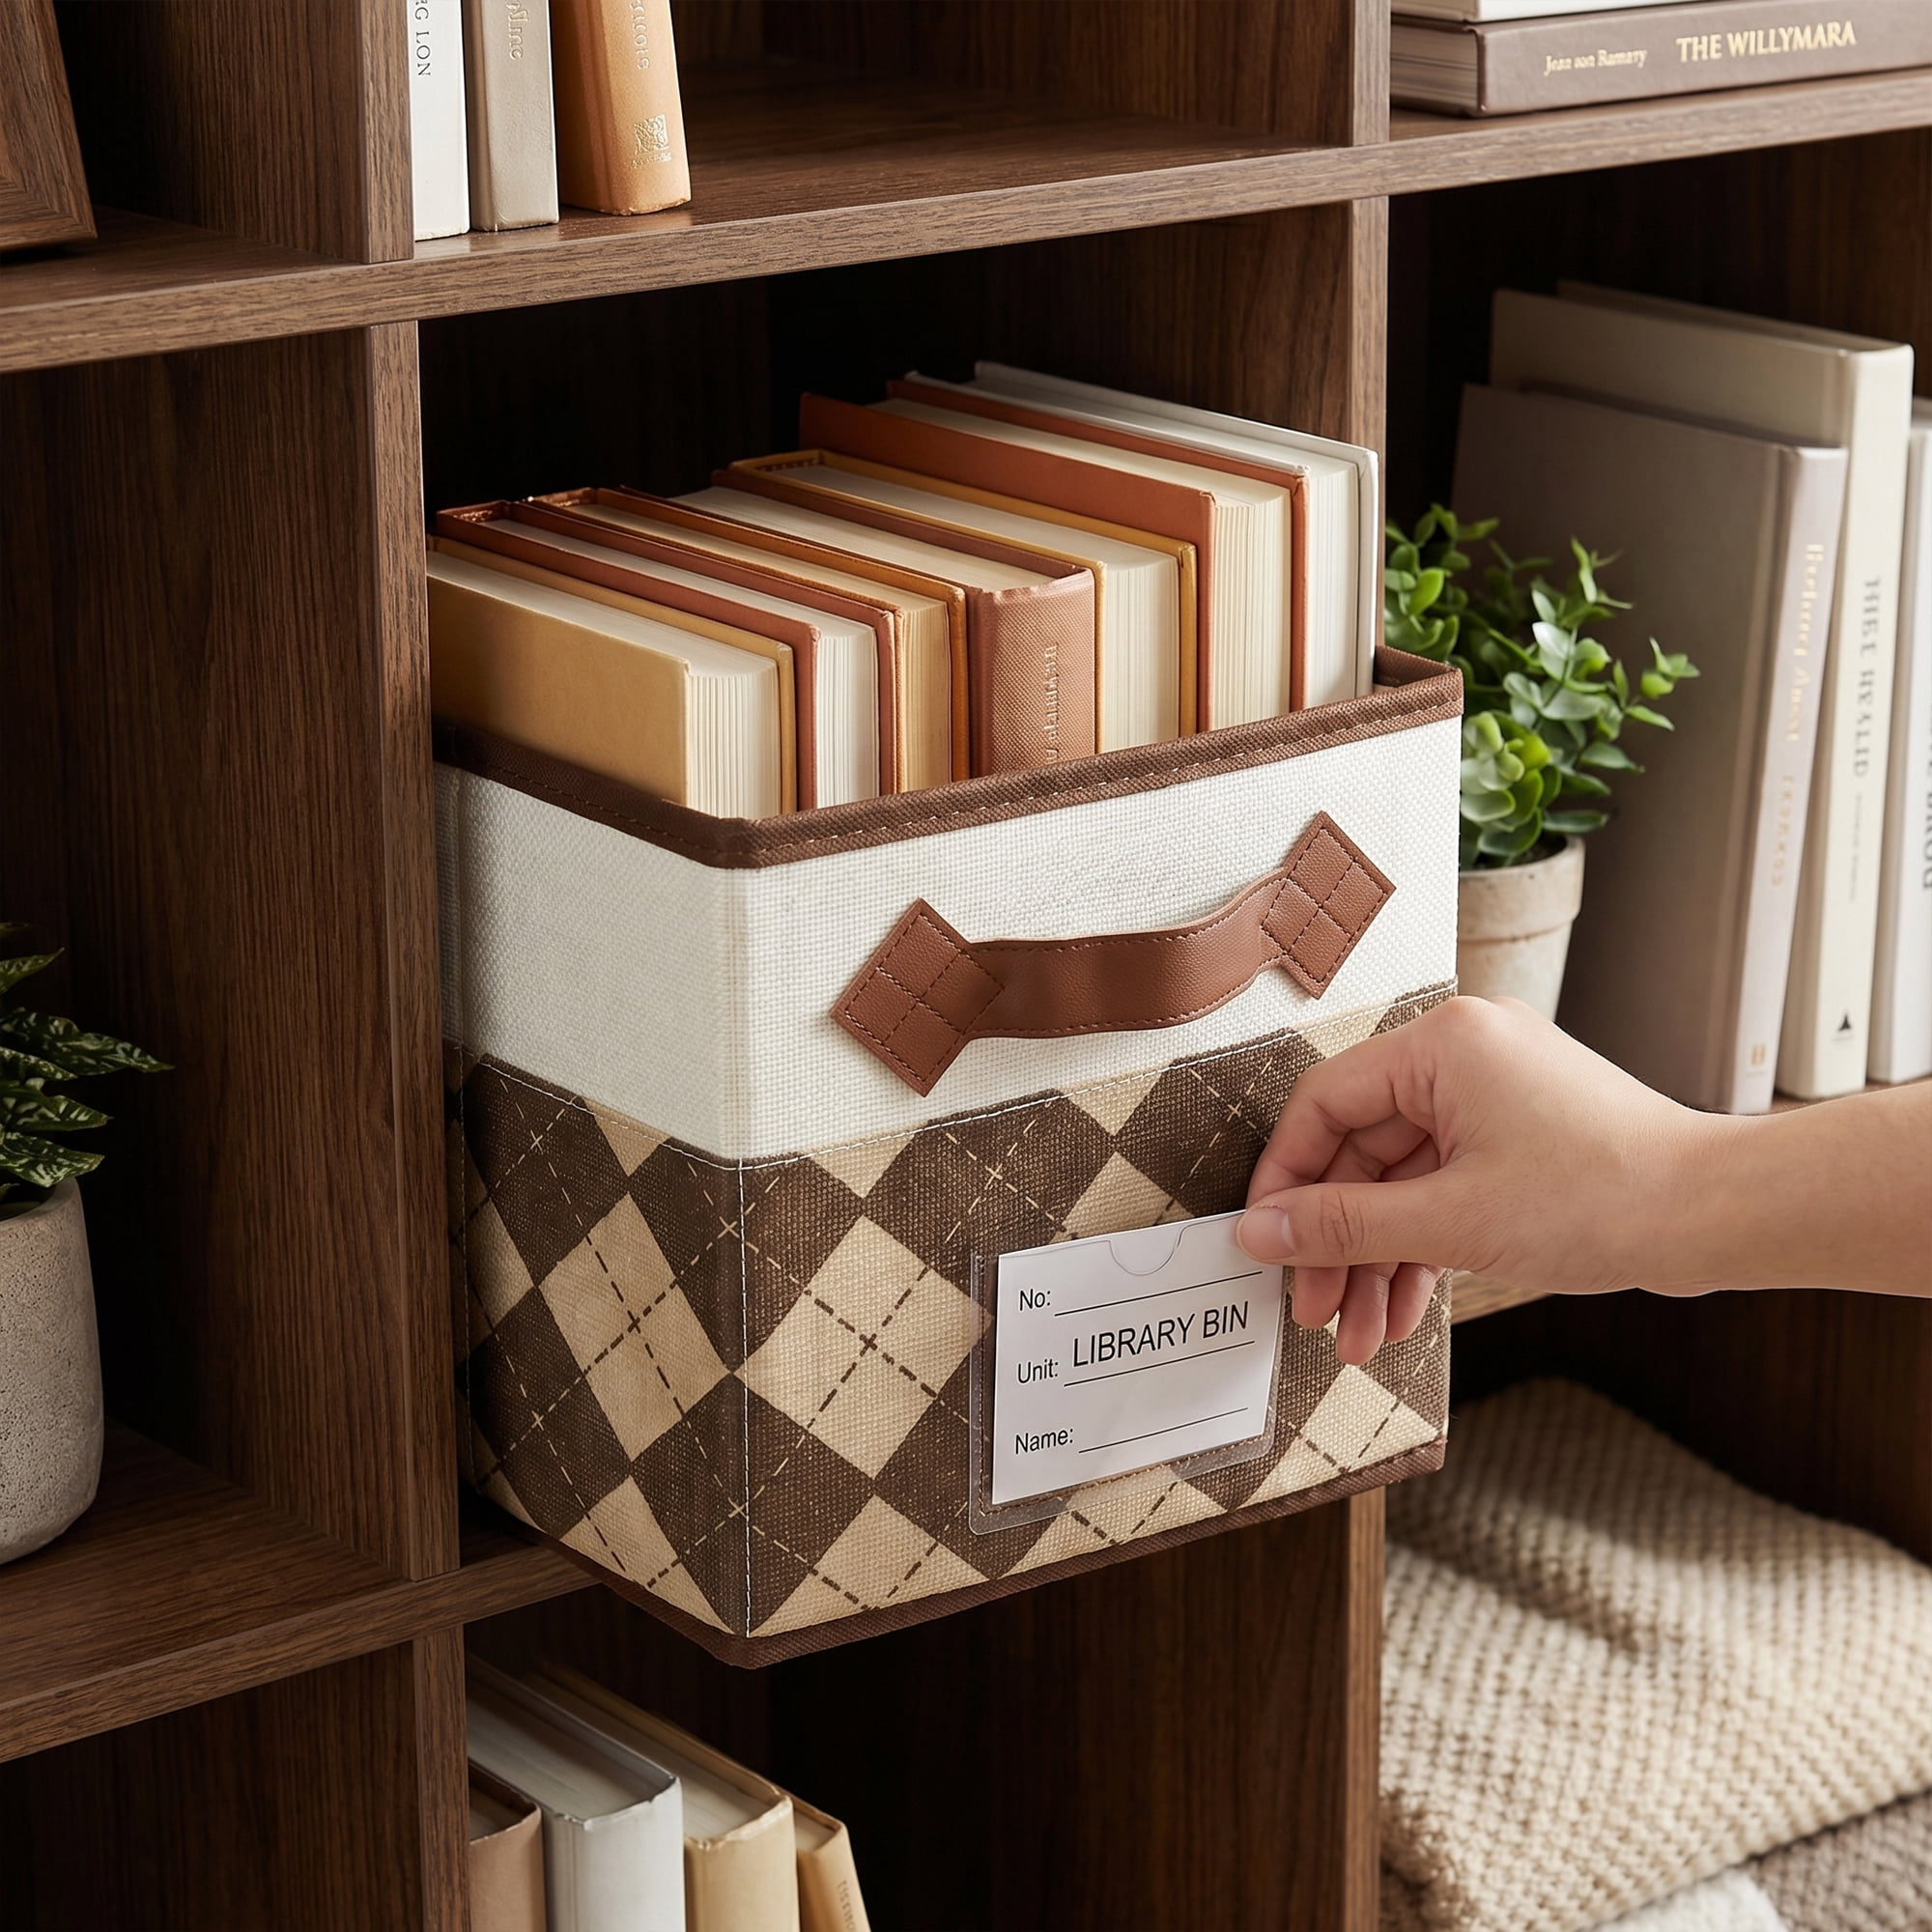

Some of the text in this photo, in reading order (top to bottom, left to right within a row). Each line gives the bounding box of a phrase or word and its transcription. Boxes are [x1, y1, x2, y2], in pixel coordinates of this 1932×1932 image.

[415, 31, 432, 77] LON
[1675, 20, 1857, 63] THE WILLYMARA
[1019, 1289, 1051, 1311] No:
[1017, 1300, 1249, 1384] Unit: LIBRARY BIN
[1014, 1428, 1074, 1455] Name:
